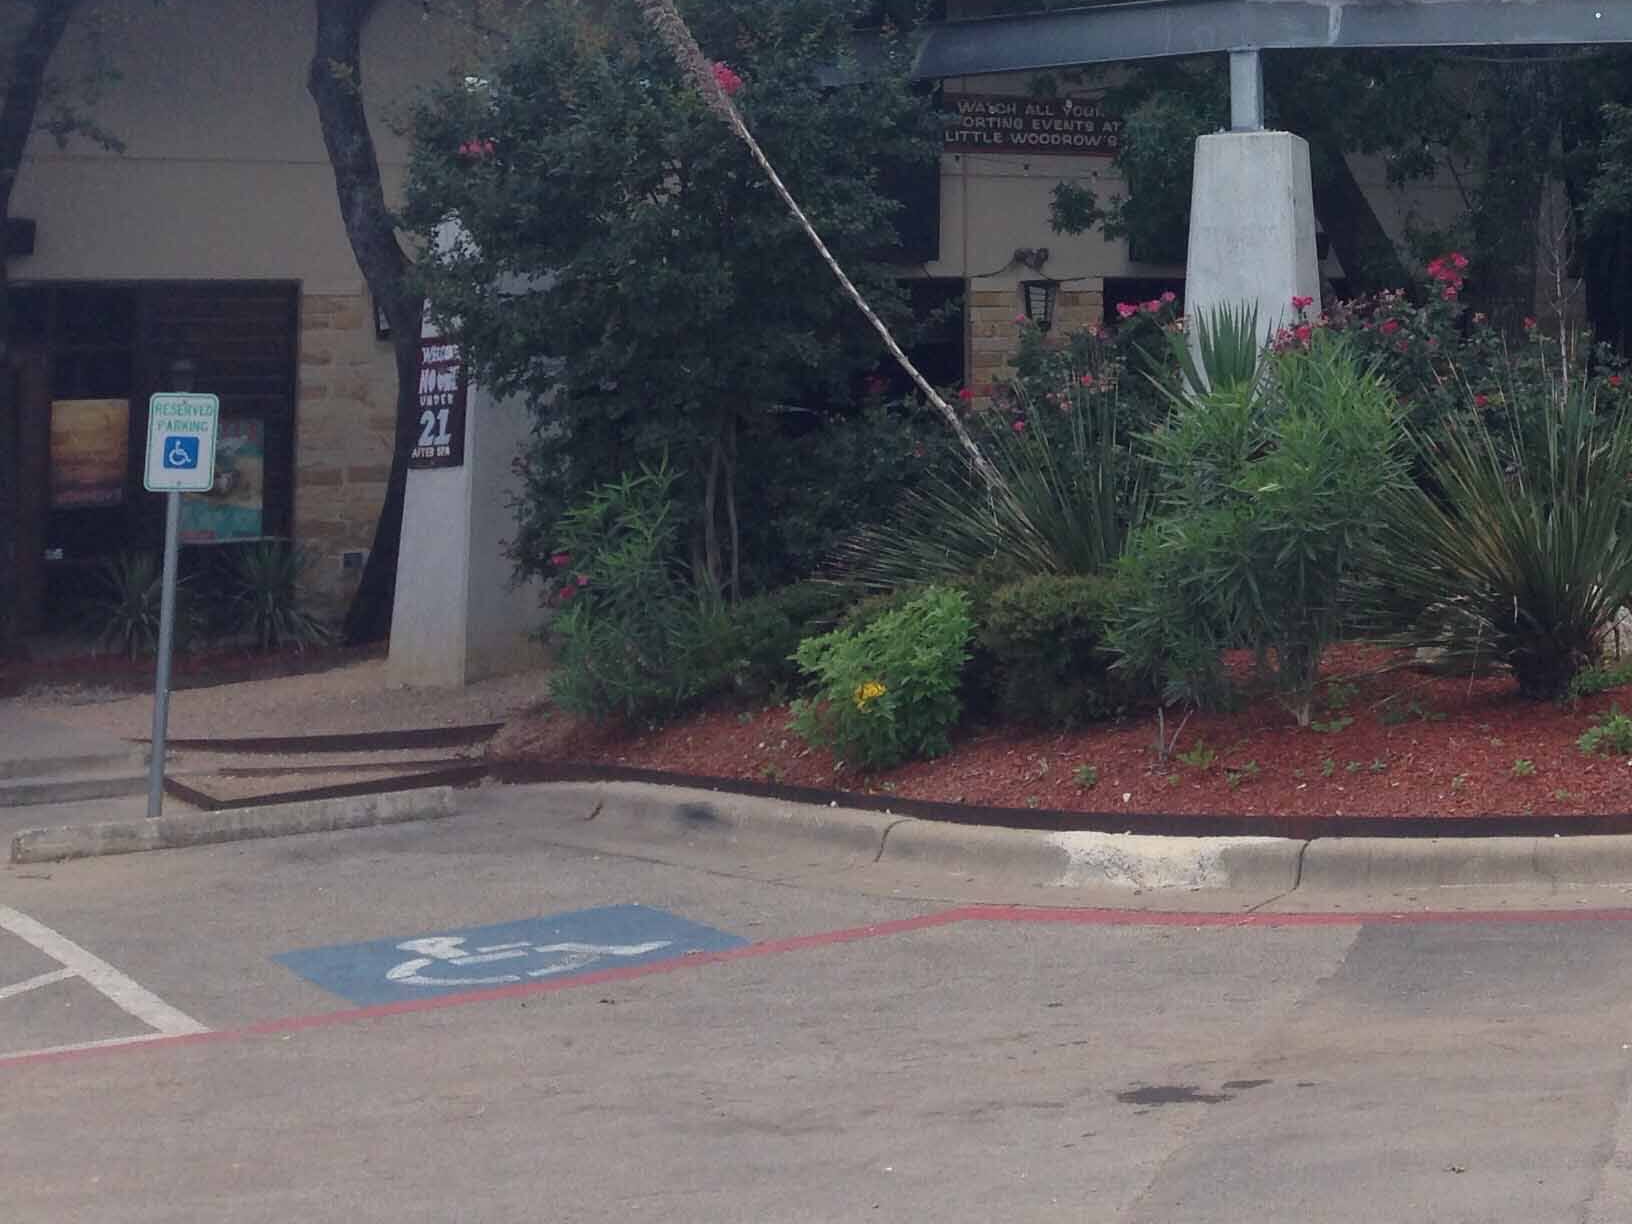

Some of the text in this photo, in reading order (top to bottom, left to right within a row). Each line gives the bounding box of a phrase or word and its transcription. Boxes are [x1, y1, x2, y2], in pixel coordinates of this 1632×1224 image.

[1025, 103, 1054, 117] ALL
[960, 116, 1121, 133] ORTING EVENTS AT
[945, 130, 1119, 147] LITTLE WOODROW'S
[419, 393, 454, 406] UNDER
[155, 401, 212, 416] RESERVED
[157, 420, 208, 433] PARKING
[418, 408, 451, 446] 21
